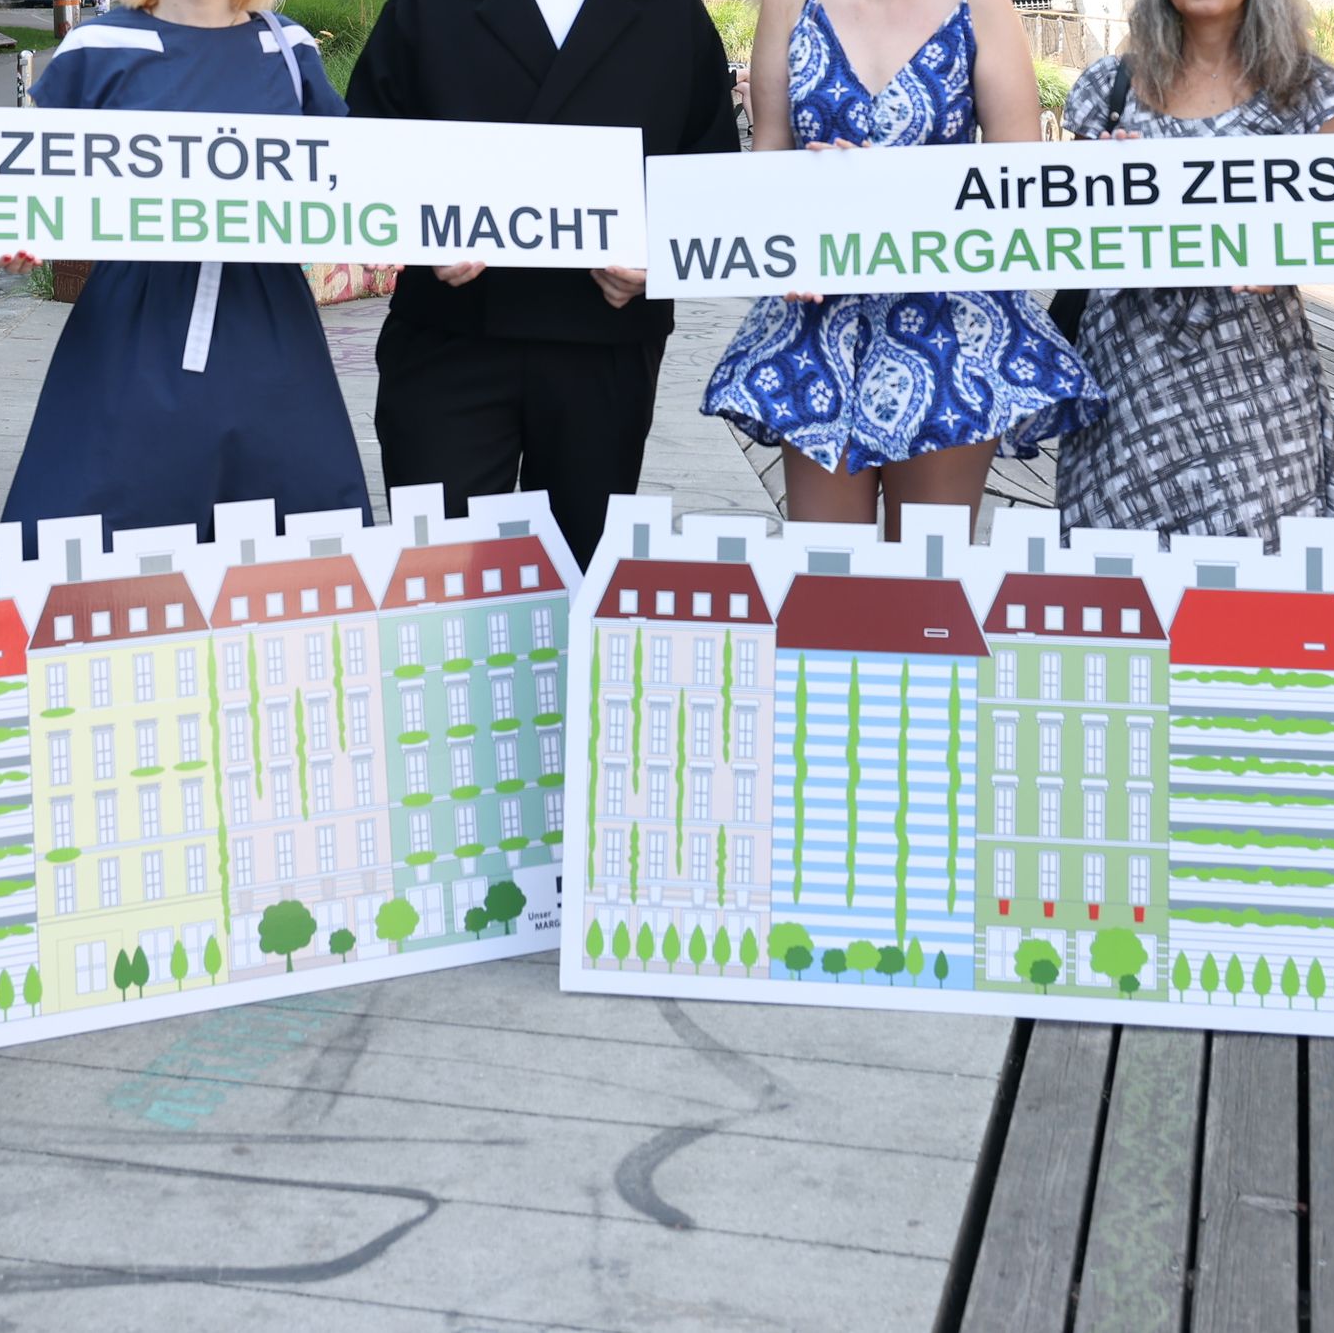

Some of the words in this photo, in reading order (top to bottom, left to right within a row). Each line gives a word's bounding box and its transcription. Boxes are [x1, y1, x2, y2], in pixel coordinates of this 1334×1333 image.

[954, 160, 1161, 211] AirBnB
[90, 195, 400, 247] LEBENDIG
[419, 203, 620, 252] MACHT
[668, 233, 798, 281] WAS
[818, 221, 1249, 278] MARGARETEN
[528, 911, 552, 921] Unser
